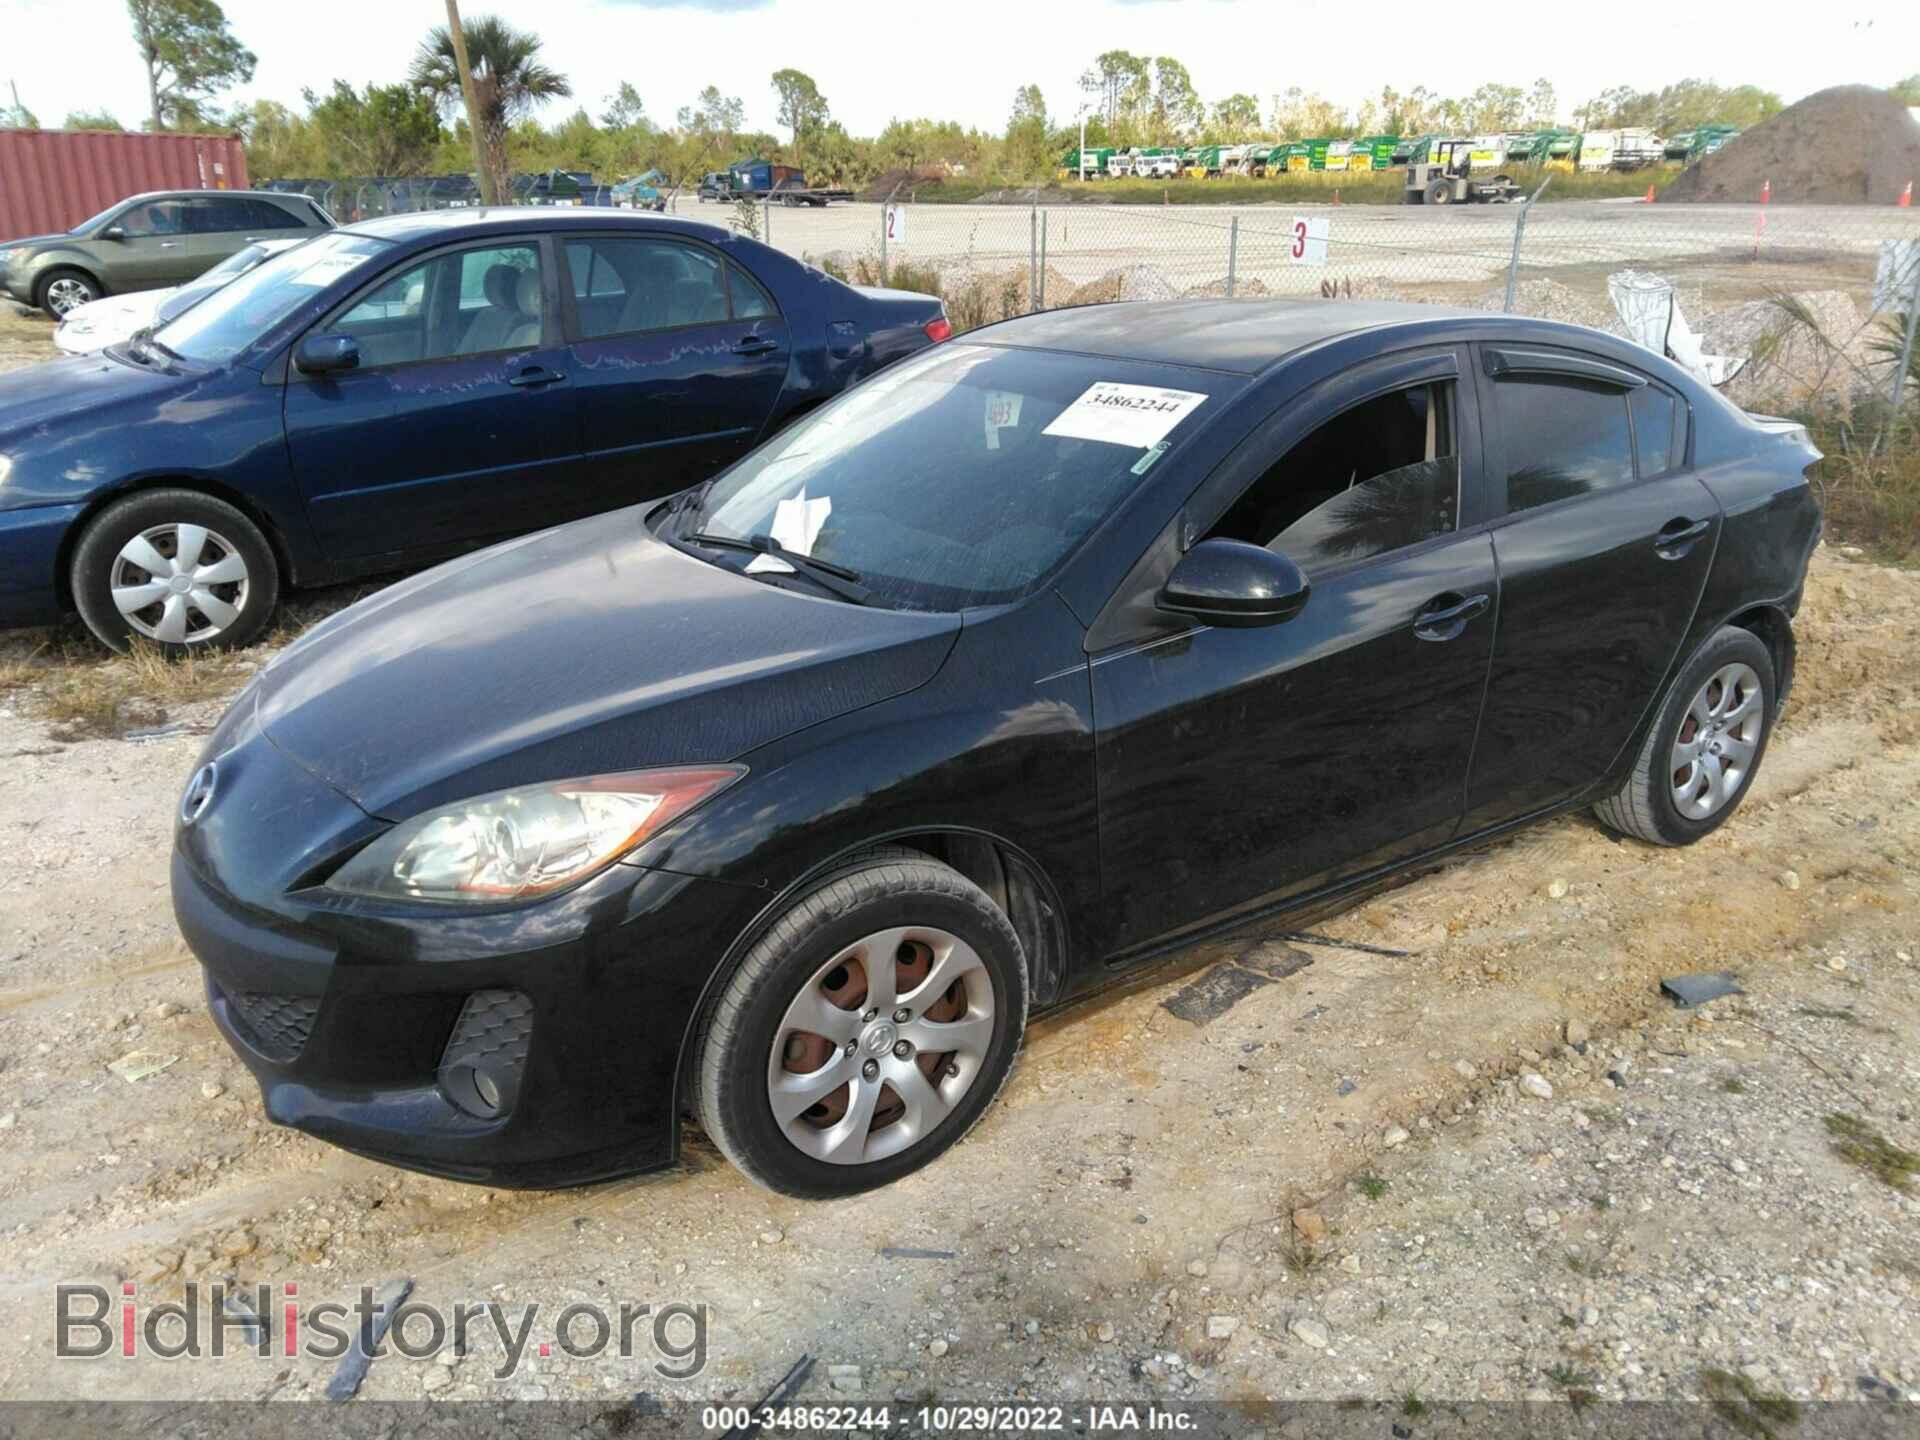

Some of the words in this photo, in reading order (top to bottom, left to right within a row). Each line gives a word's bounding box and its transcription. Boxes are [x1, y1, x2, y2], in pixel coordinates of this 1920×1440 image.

[887, 211, 895, 238] 2
[1293, 221, 1306, 258] 3
[1086, 393, 1181, 413] 34862244
